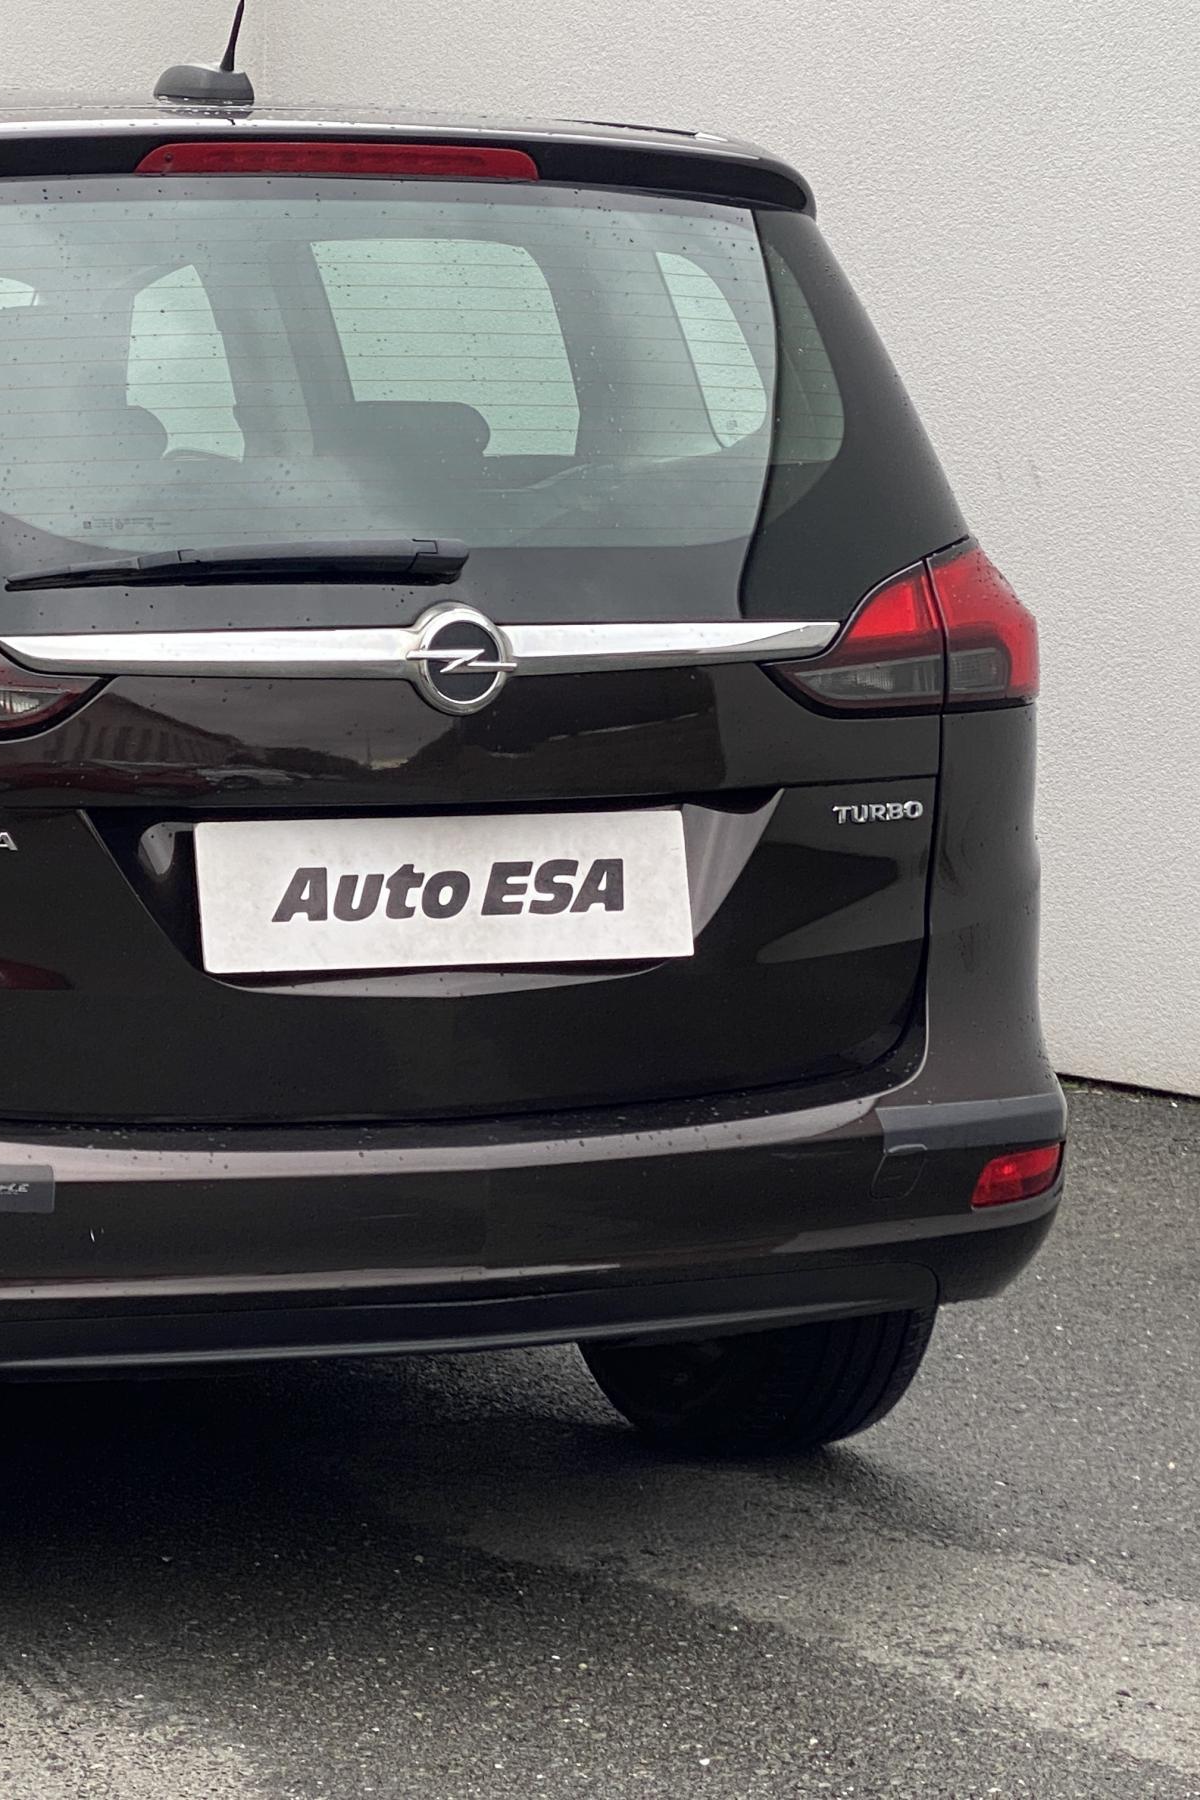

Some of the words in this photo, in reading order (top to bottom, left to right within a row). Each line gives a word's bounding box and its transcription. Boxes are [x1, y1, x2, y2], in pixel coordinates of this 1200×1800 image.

[832, 800, 924, 824] TURBO
[271, 863, 471, 923] Auto
[481, 858, 624, 916] ESA
